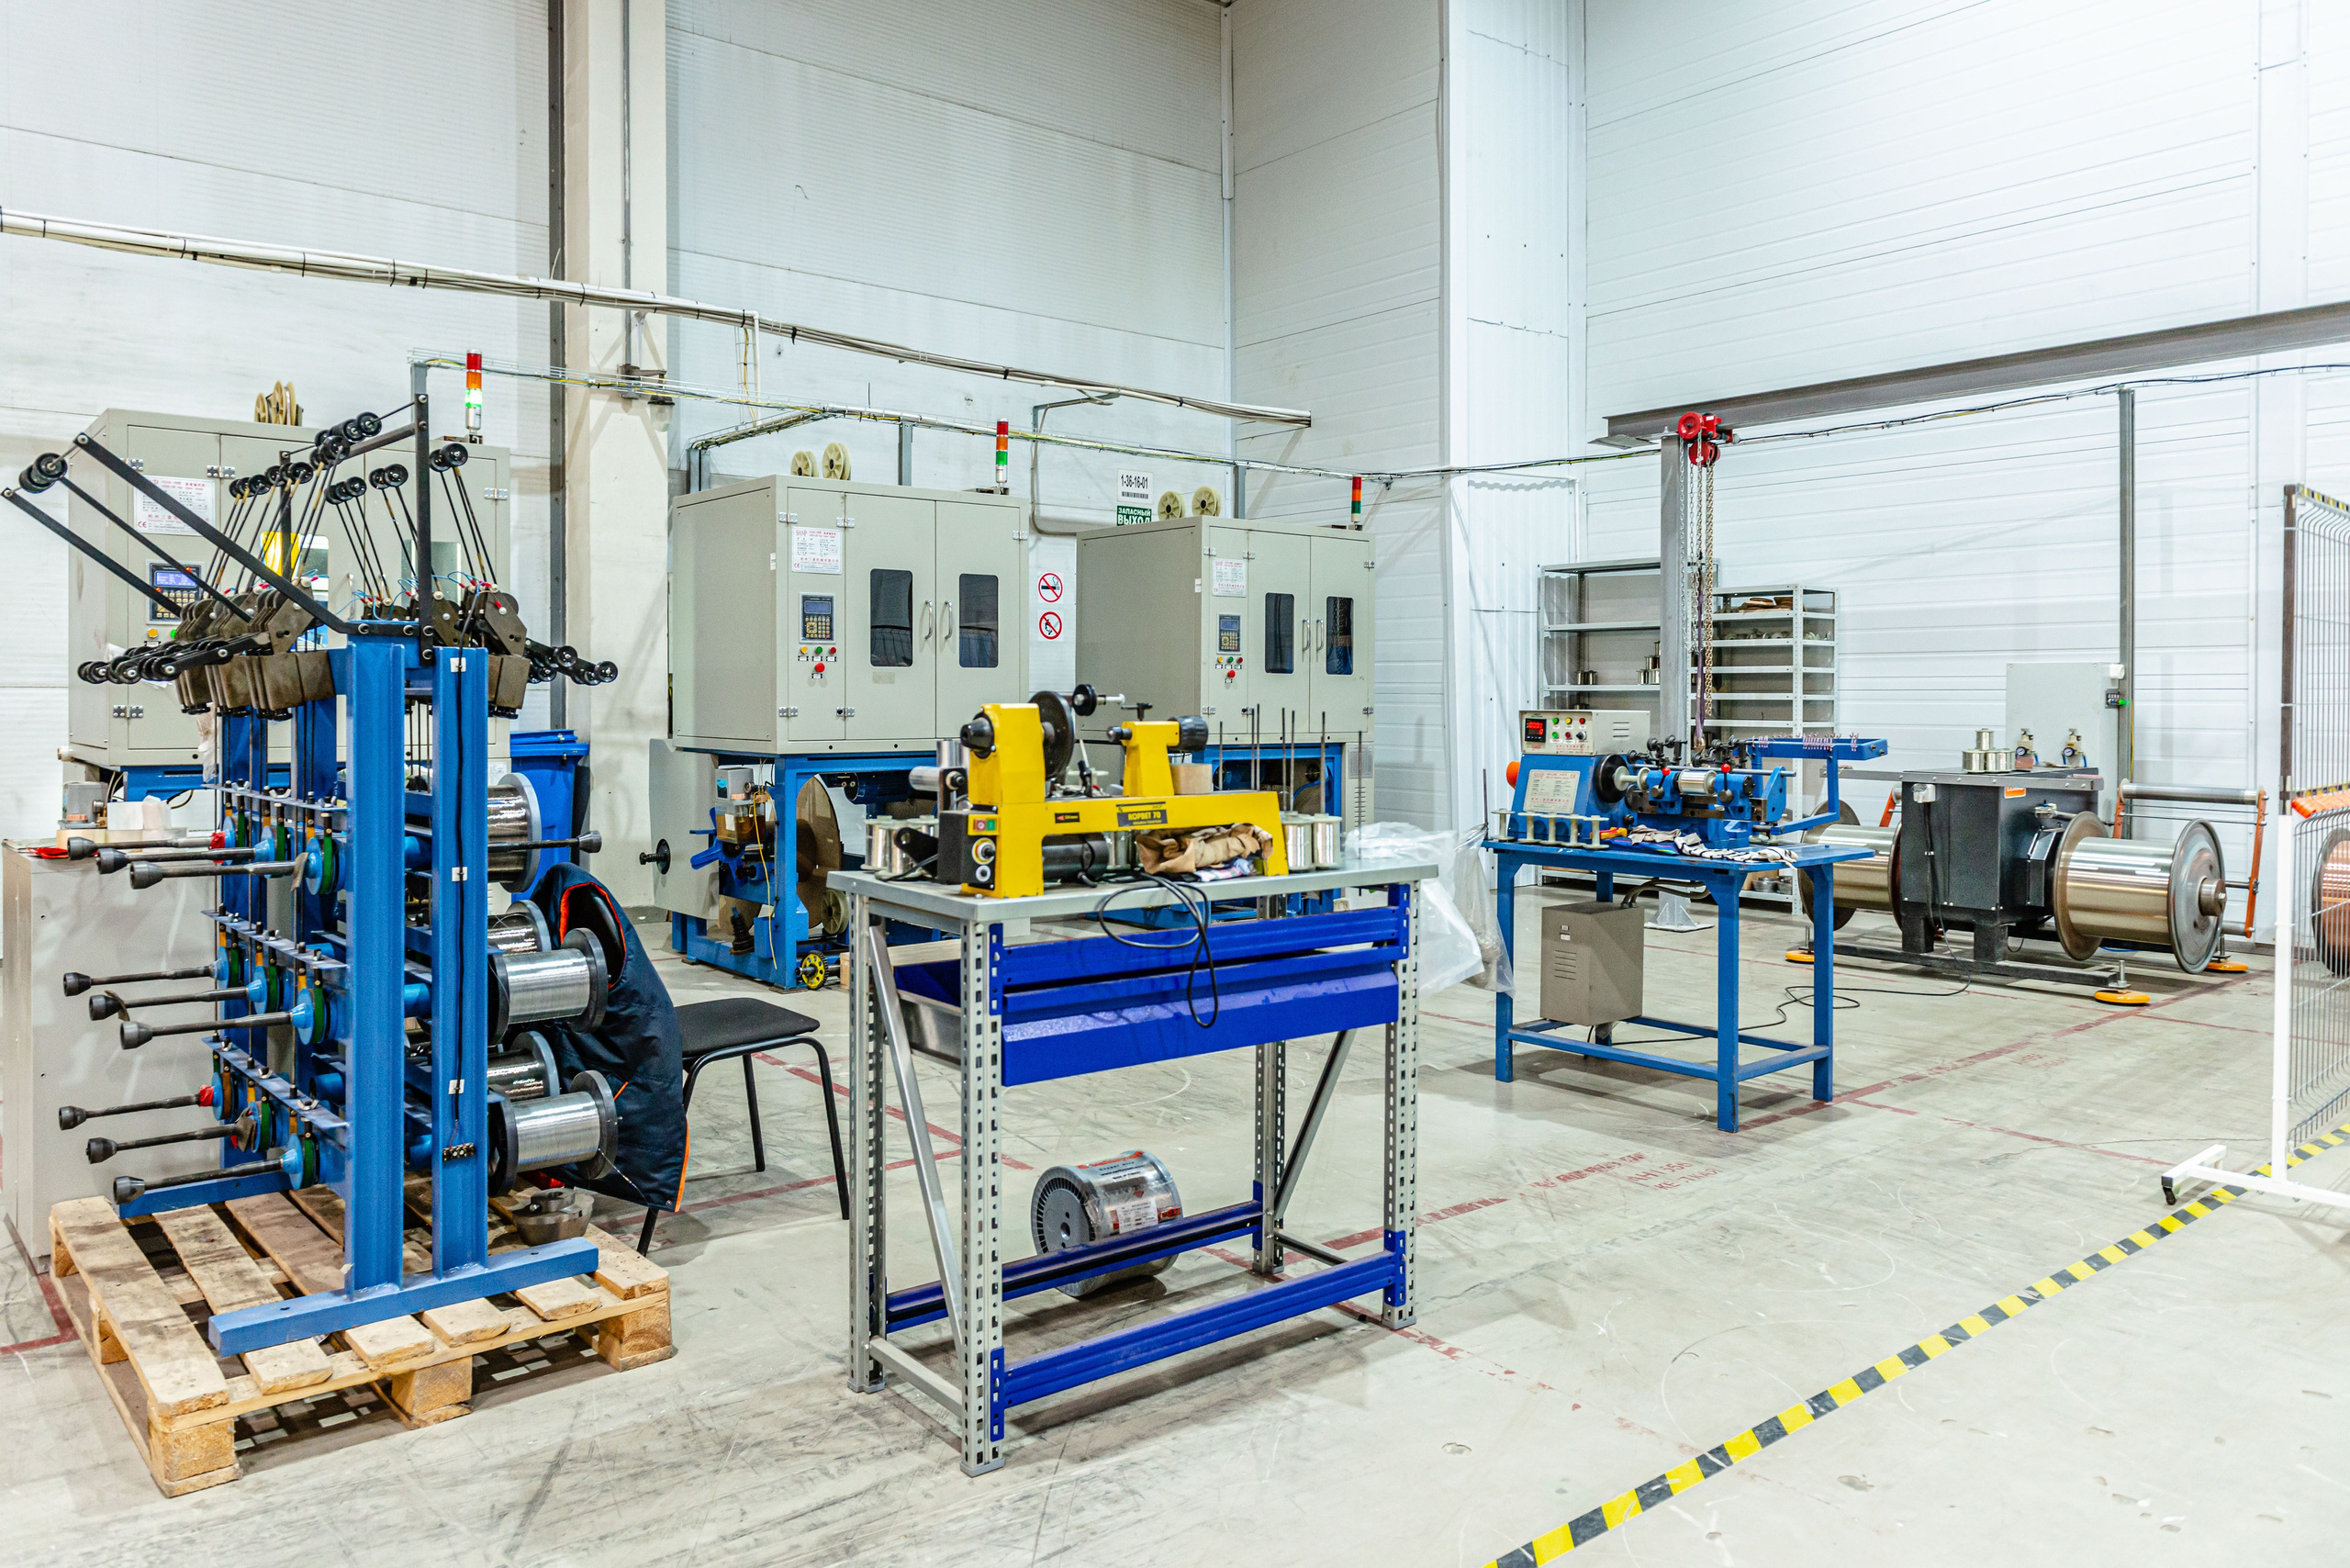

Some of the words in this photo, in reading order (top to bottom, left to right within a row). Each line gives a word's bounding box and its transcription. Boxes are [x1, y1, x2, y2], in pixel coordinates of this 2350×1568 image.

[1121, 474, 1148, 489] 1-36-16-01
[1118, 507, 1150, 517] ЗАПАСНЫЙ
[1117, 514, 1150, 526] ВЫХОД
[1152, 811, 1161, 819] 70
